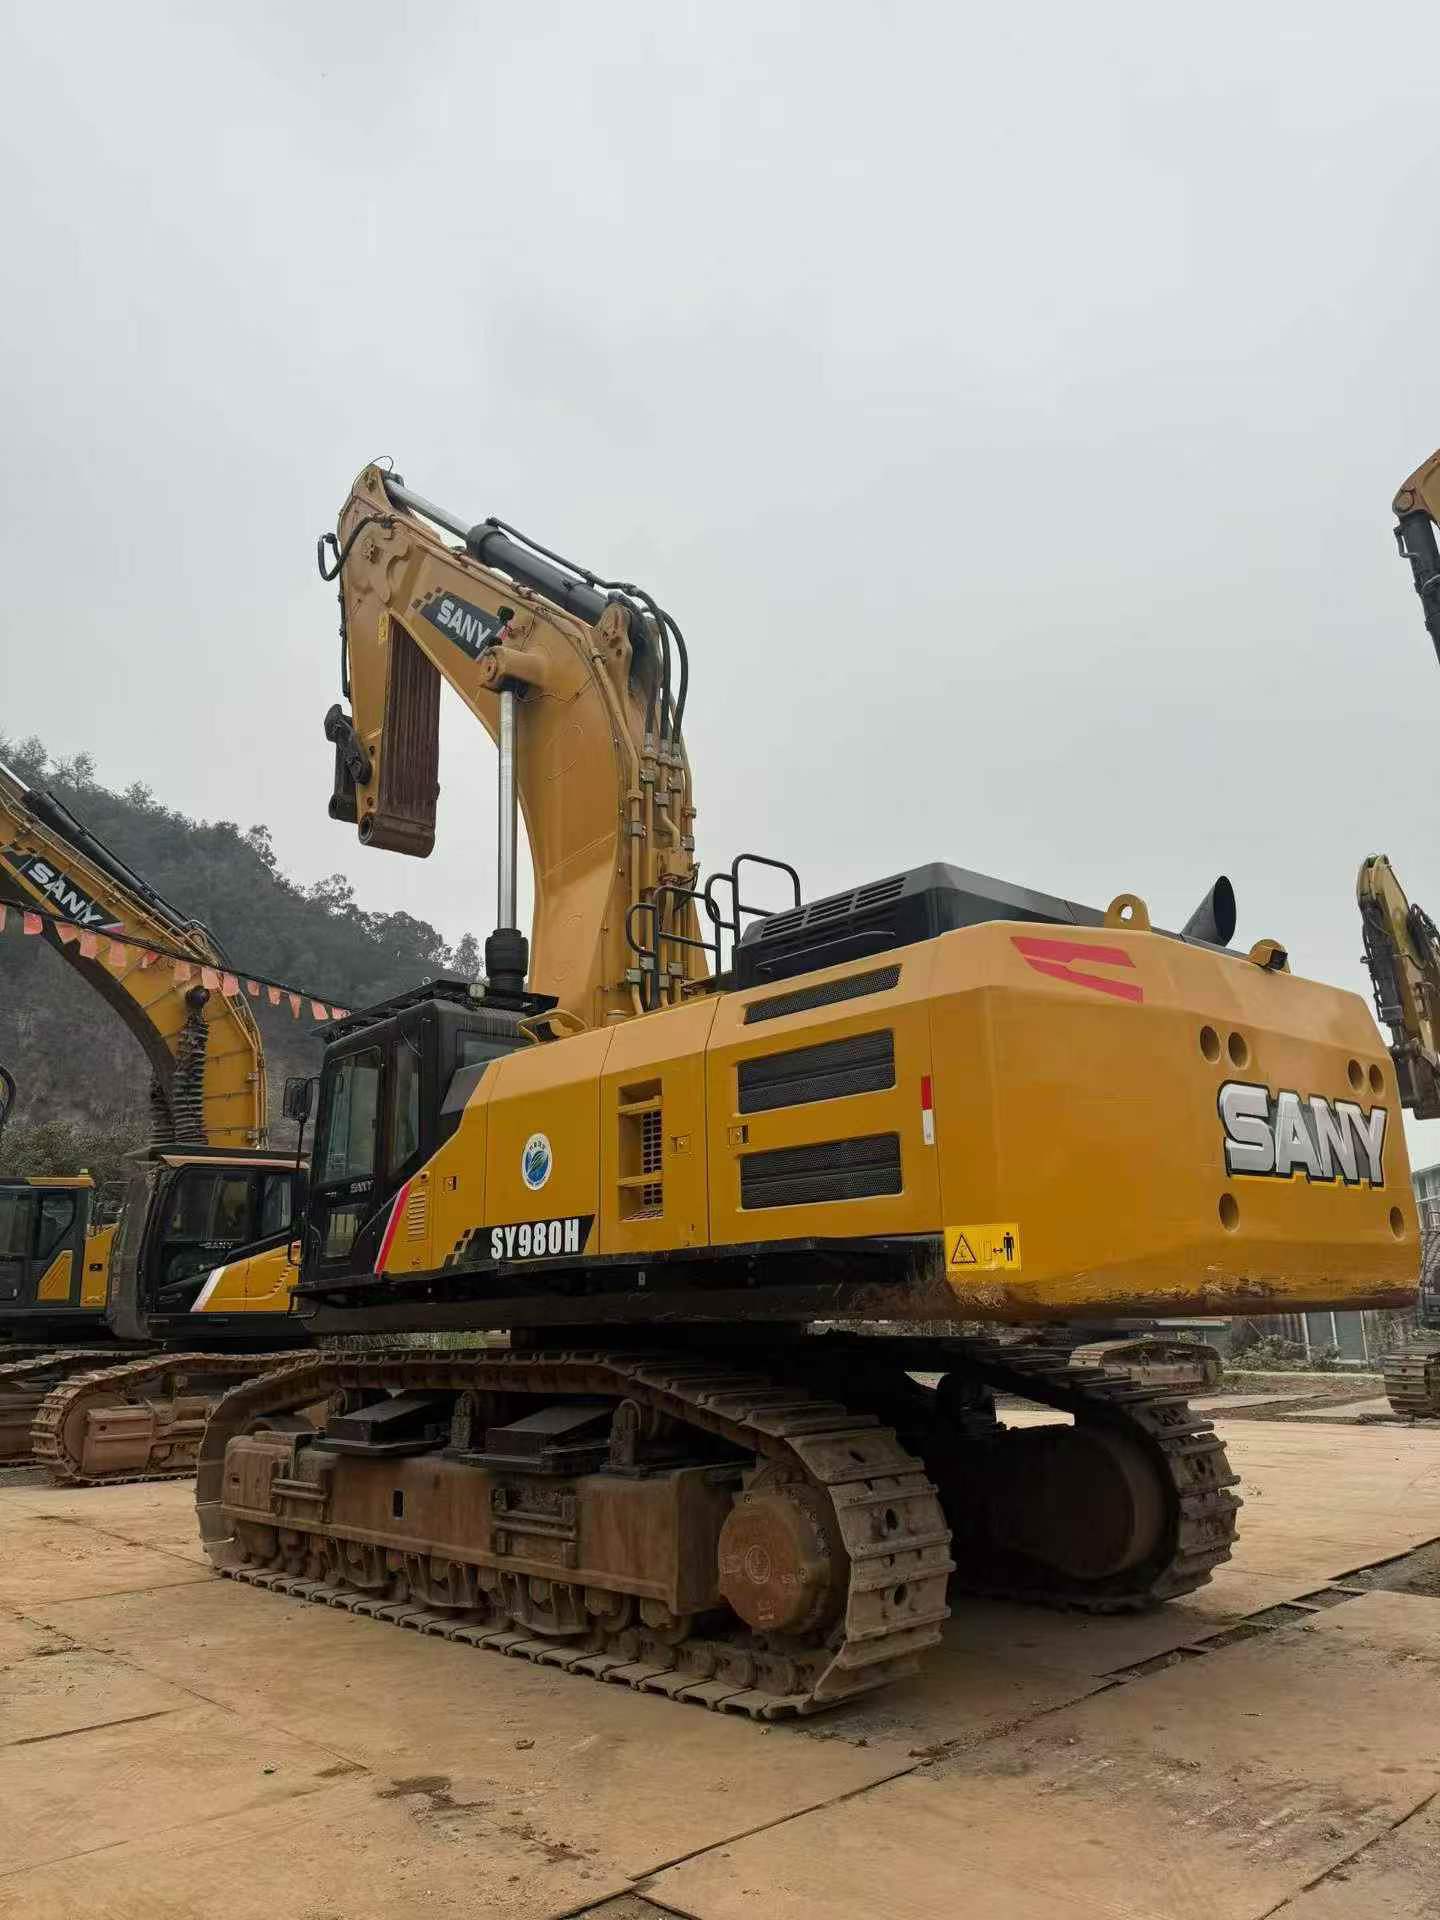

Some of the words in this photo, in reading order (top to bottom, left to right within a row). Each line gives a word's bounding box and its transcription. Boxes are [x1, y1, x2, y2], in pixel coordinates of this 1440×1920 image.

[437, 600, 492, 648] SANY
[28, 863, 103, 923] SANY
[1218, 1080, 1387, 1188] SANY
[491, 1219, 579, 1259] SY980H
